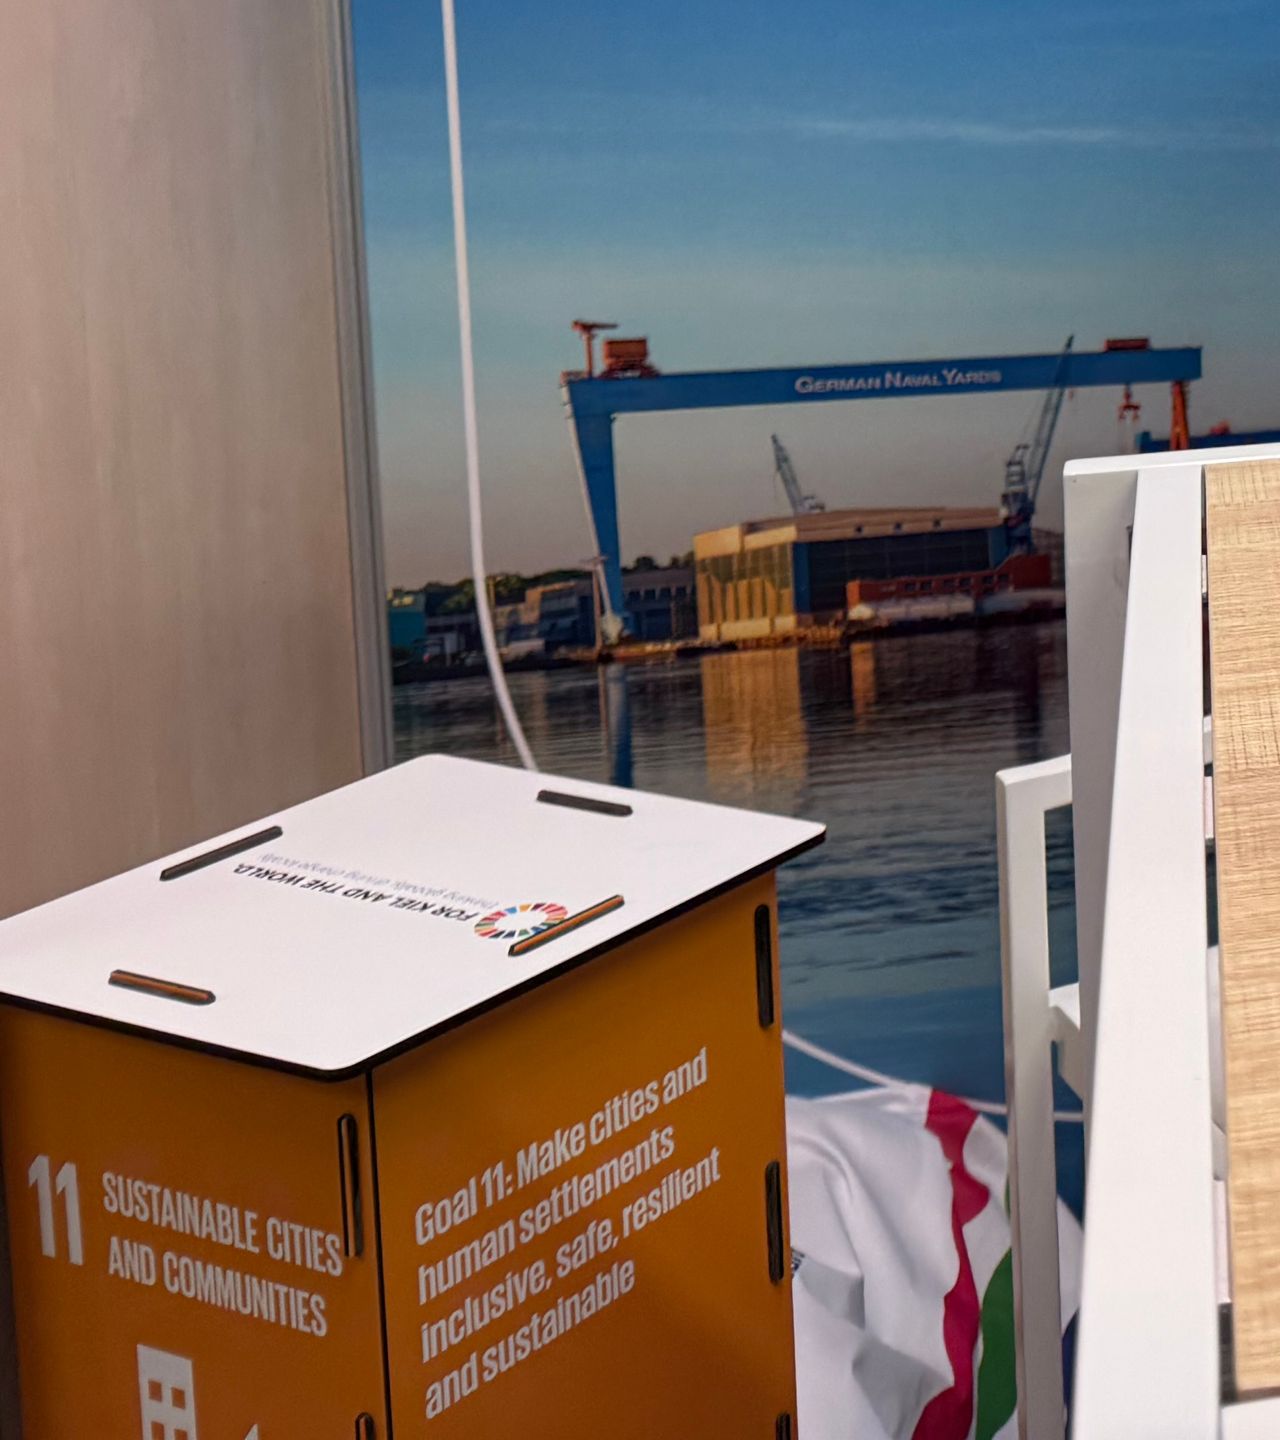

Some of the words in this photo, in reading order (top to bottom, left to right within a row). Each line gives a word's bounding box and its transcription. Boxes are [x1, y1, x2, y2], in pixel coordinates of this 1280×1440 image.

[300, 879, 344, 895] THE
[343, 888, 392, 903] AND
[390, 897, 435, 915] KIEL
[431, 907, 481, 922] FOR
[415, 1176, 478, 1246] Goal
[480, 1160, 513, 1207] 11:
[517, 1122, 586, 1189] Make
[589, 1079, 659, 1146] cities
[662, 1046, 707, 1105] and
[28, 1154, 83, 1266] 11
[102, 1171, 259, 1254] SUSTAINABLE
[266, 1216, 343, 1277] CITIES
[418, 1219, 516, 1305] human
[519, 1125, 675, 1244] settlements
[421, 1259, 552, 1363] inclusive,
[556, 1217, 619, 1279] safe,
[622, 1147, 721, 1239] resilient
[108, 1236, 157, 1286] AND
[162, 1251, 328, 1337] COMMUNITIES
[425, 1353, 478, 1419] and
[482, 1259, 635, 1382] sustainable
